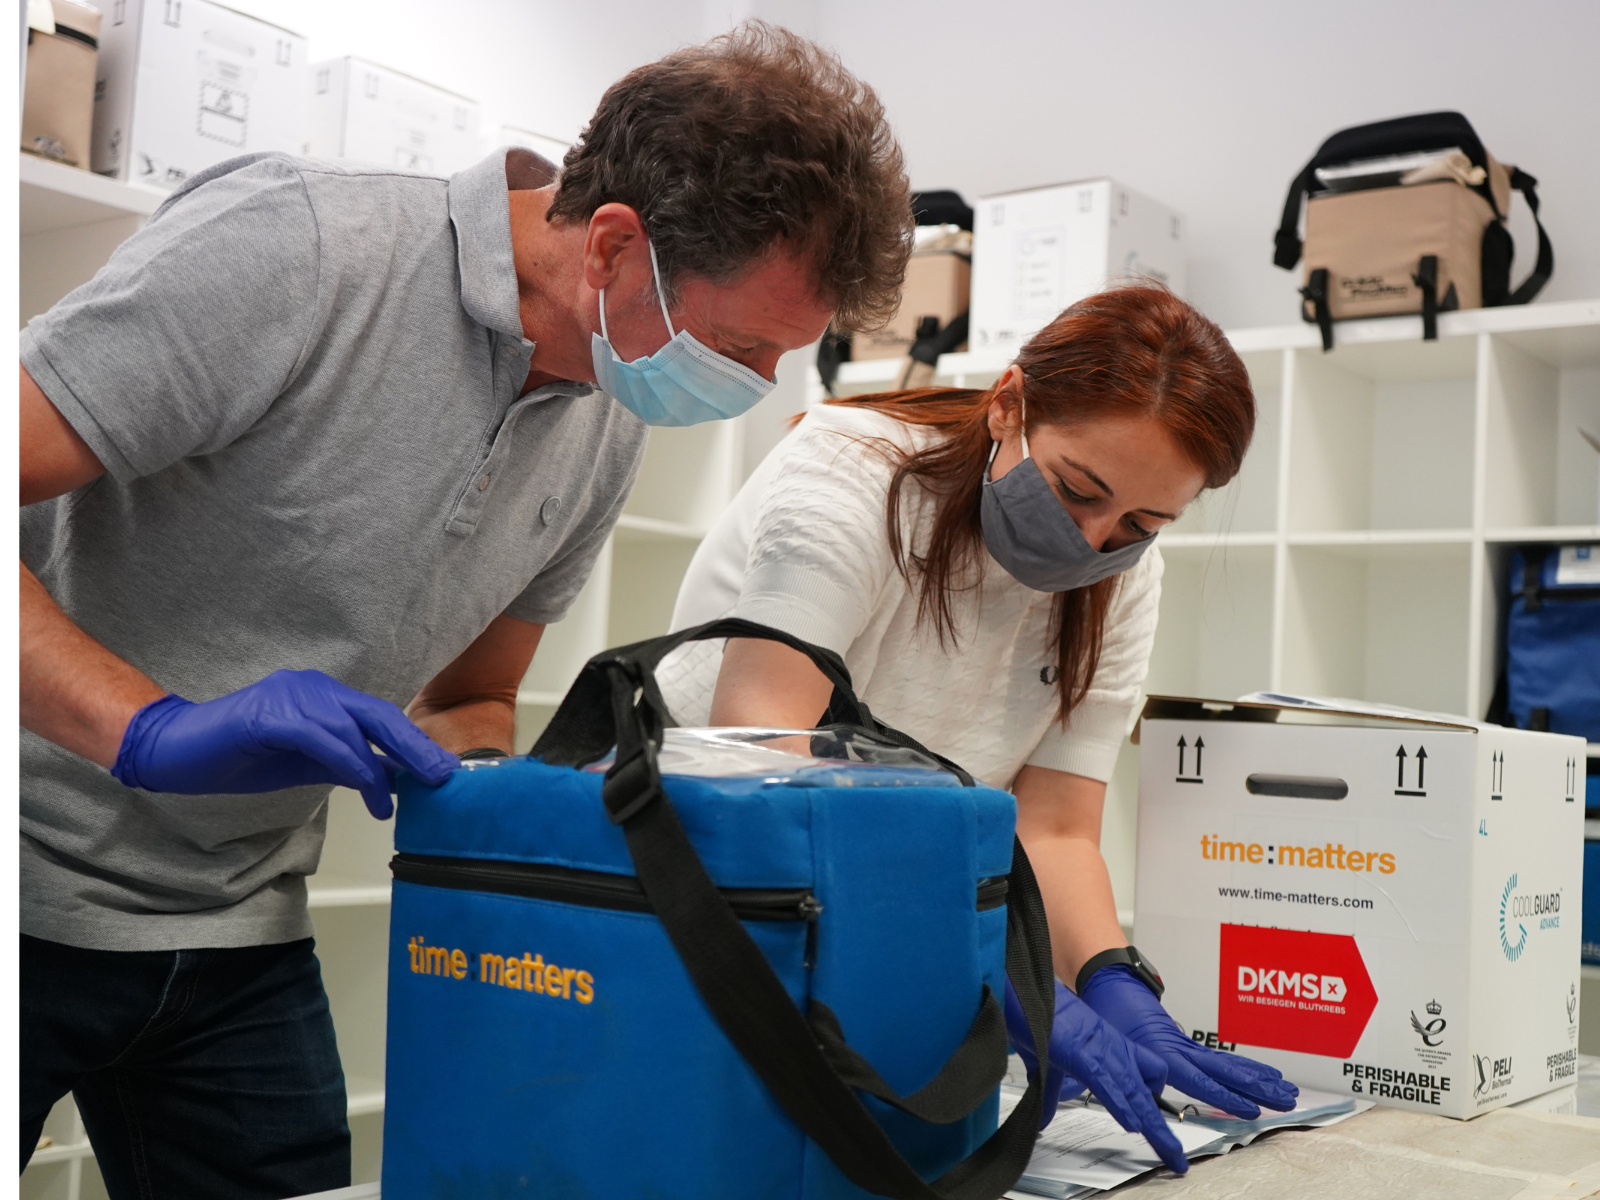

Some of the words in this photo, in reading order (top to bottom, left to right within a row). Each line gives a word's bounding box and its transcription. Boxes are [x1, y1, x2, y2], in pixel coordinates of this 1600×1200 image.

[1478, 819, 1488, 836] 4L
[1200, 834, 1397, 875] time:matters
[1218, 886, 1374, 910] www.time-matters.com
[1512, 893, 1561, 918] COOLGUARD
[1539, 916, 1560, 930] ADVANCE
[1237, 994, 1255, 1005] WIR
[1256, 996, 1296, 1009] BESIEGEN
[1298, 1001, 1346, 1015] BLUTKREBS
[1493, 1056, 1512, 1079] PELI
[1546, 1048, 1577, 1071] PERISHABLE
[1342, 1062, 1451, 1092] PERISHABLE
[1554, 1062, 1576, 1081] FRAGILE
[1351, 1079, 1363, 1093] &
[1369, 1081, 1441, 1106] FRAGILE
